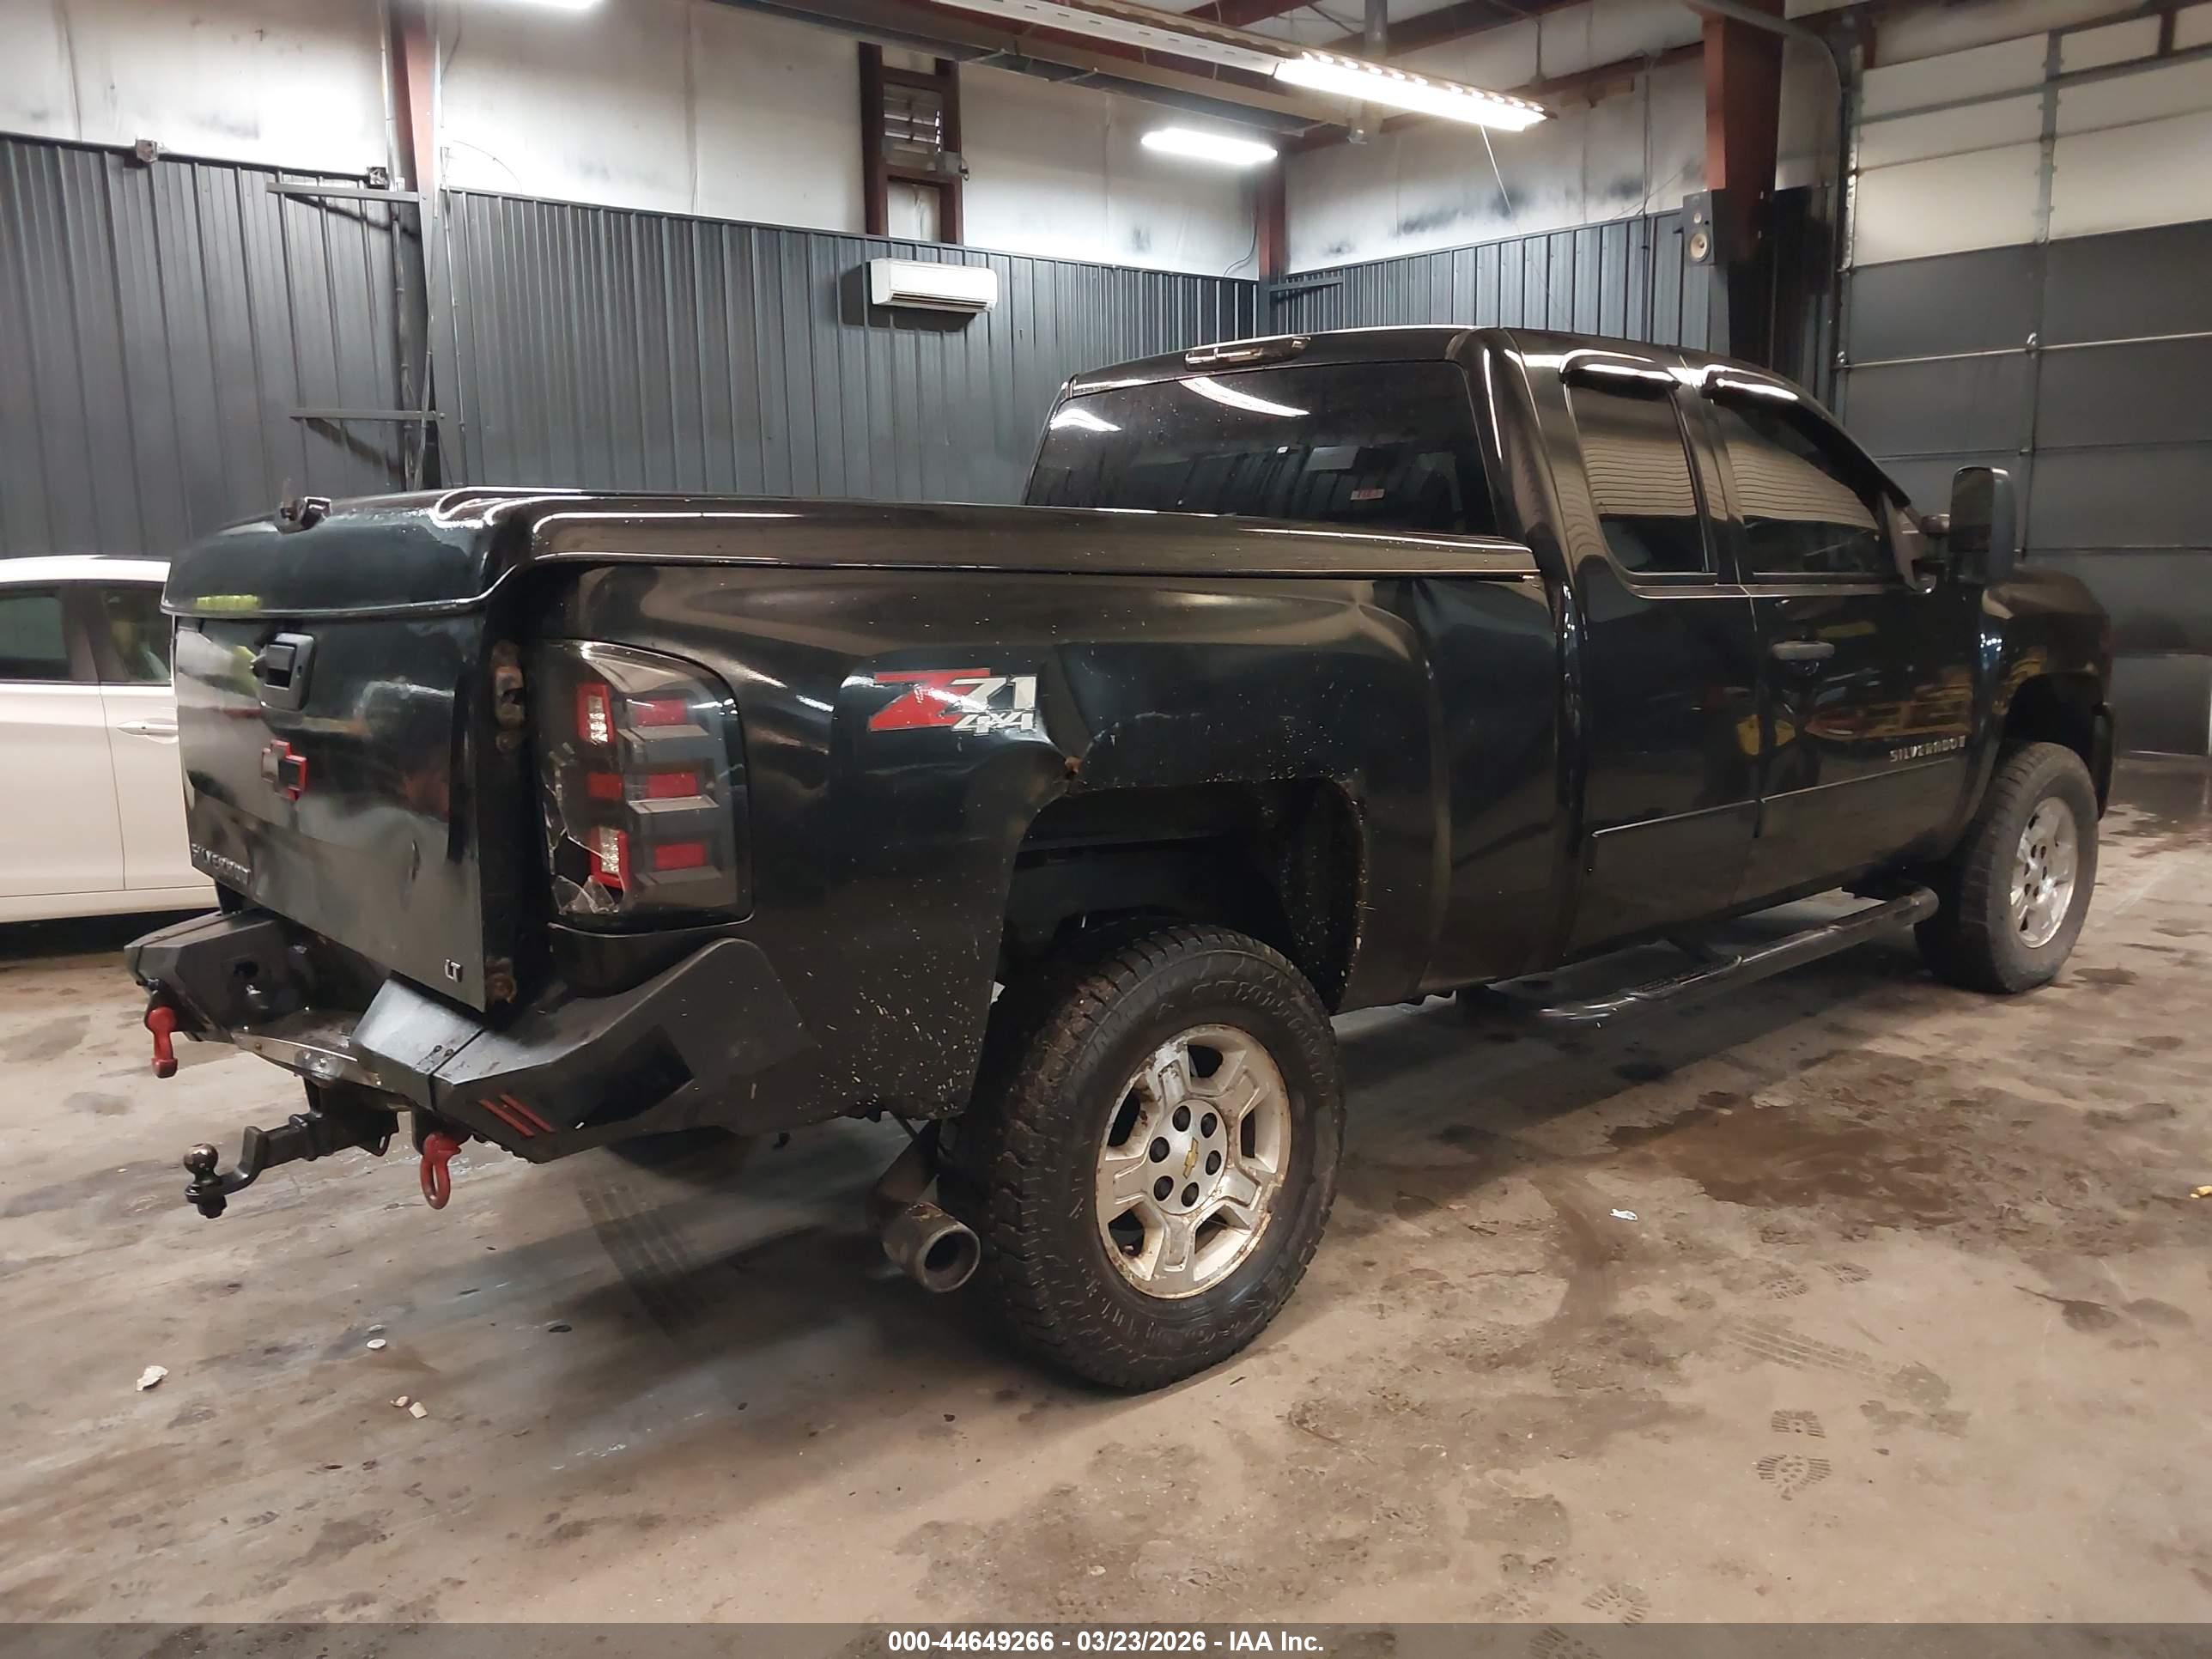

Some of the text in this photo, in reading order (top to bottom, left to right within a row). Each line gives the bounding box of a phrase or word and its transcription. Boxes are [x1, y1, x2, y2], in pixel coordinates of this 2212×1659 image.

[868, 667, 1037, 732] Z71
[1889, 738, 1958, 763] SILVERADO
[444, 958, 461, 982] LT
